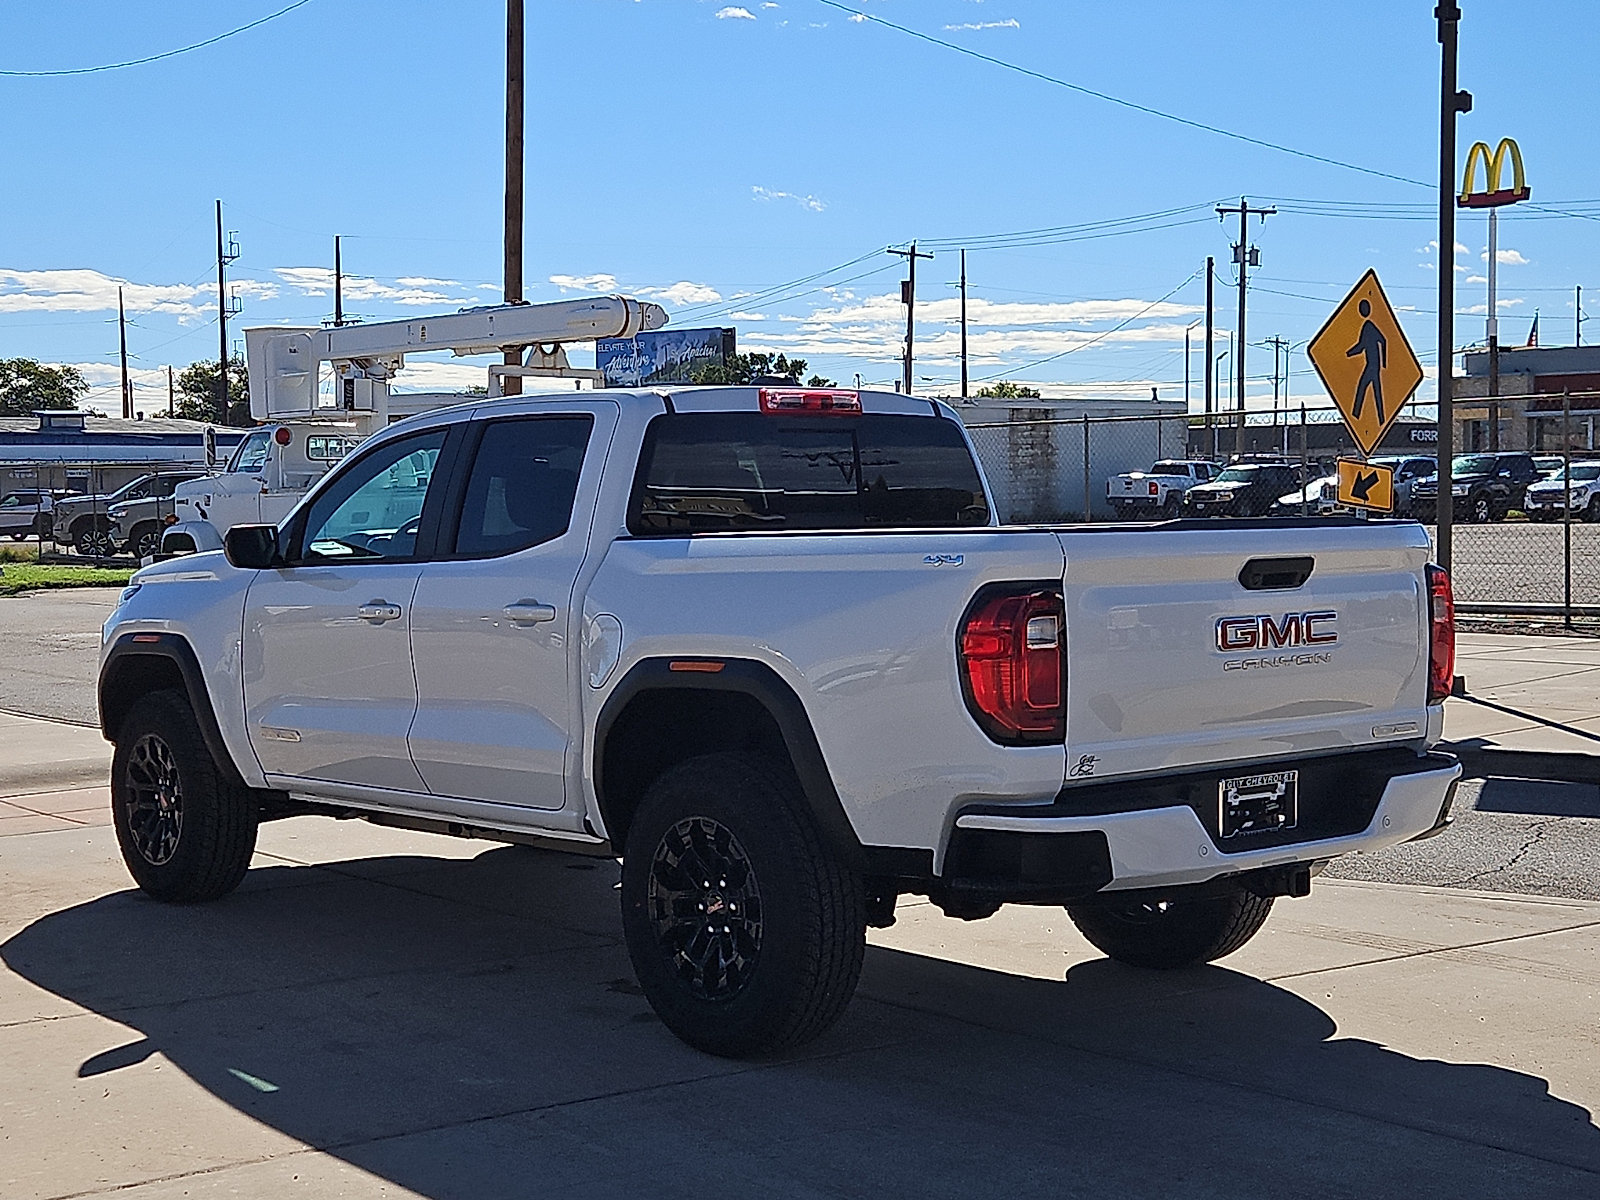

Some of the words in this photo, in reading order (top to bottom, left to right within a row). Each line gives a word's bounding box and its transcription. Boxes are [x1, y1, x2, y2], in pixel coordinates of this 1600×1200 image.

[598, 342, 625, 353] ELEVATE
[626, 341, 646, 351] YOUR
[1216, 609, 1338, 652] GMC
[1223, 653, 1332, 672] CANYON
[1246, 772, 1294, 786] CHEVROLET
